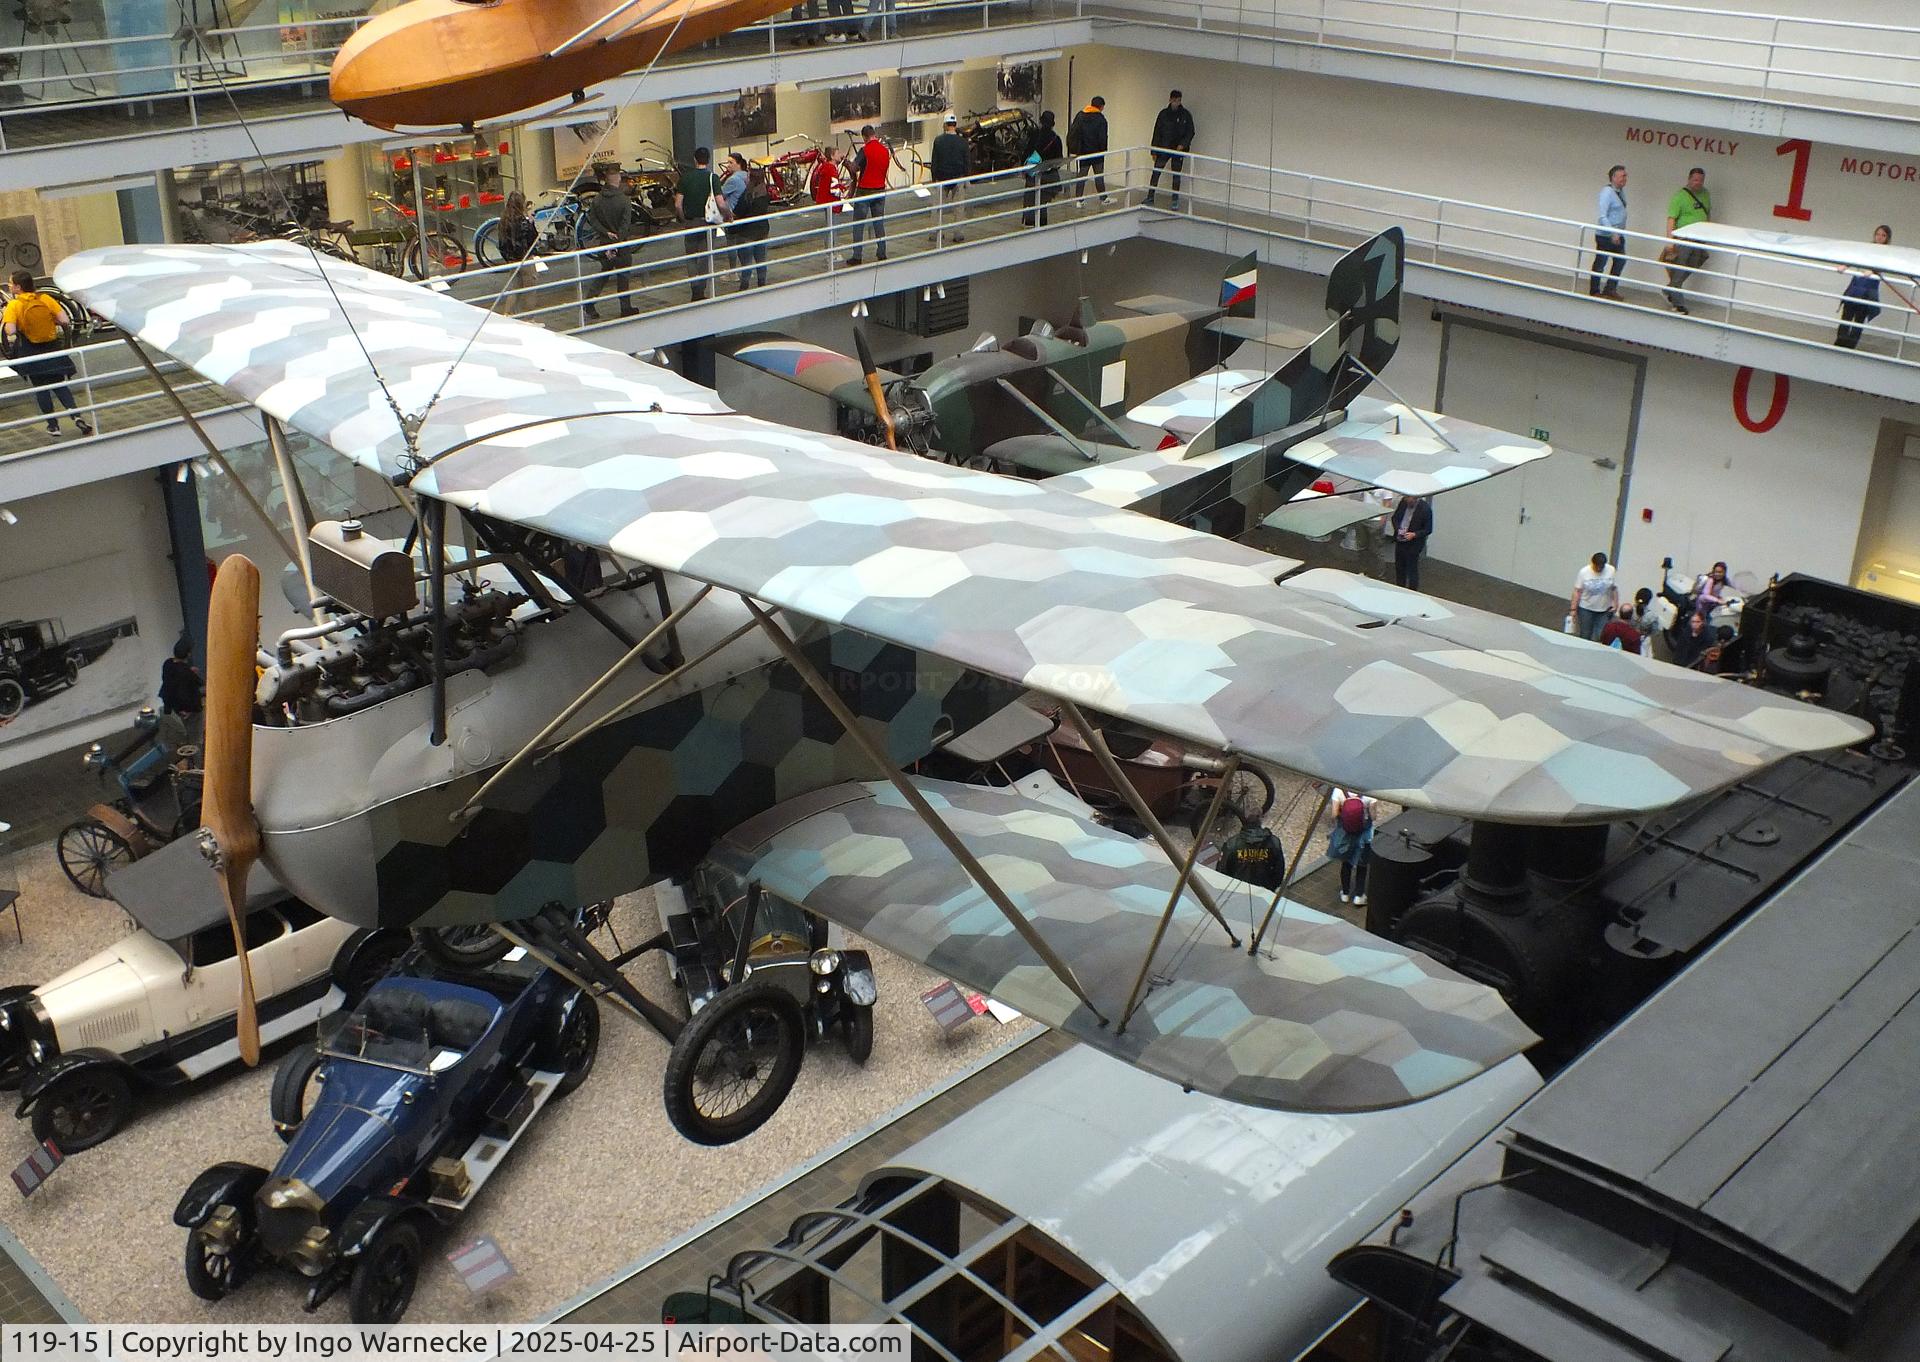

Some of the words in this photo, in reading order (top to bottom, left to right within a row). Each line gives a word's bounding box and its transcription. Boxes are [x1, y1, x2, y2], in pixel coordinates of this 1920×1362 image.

[1626, 127, 1739, 156] MOTOCYKLY
[1773, 138, 1813, 222] 1
[1840, 157, 1920, 183] MOTOR
